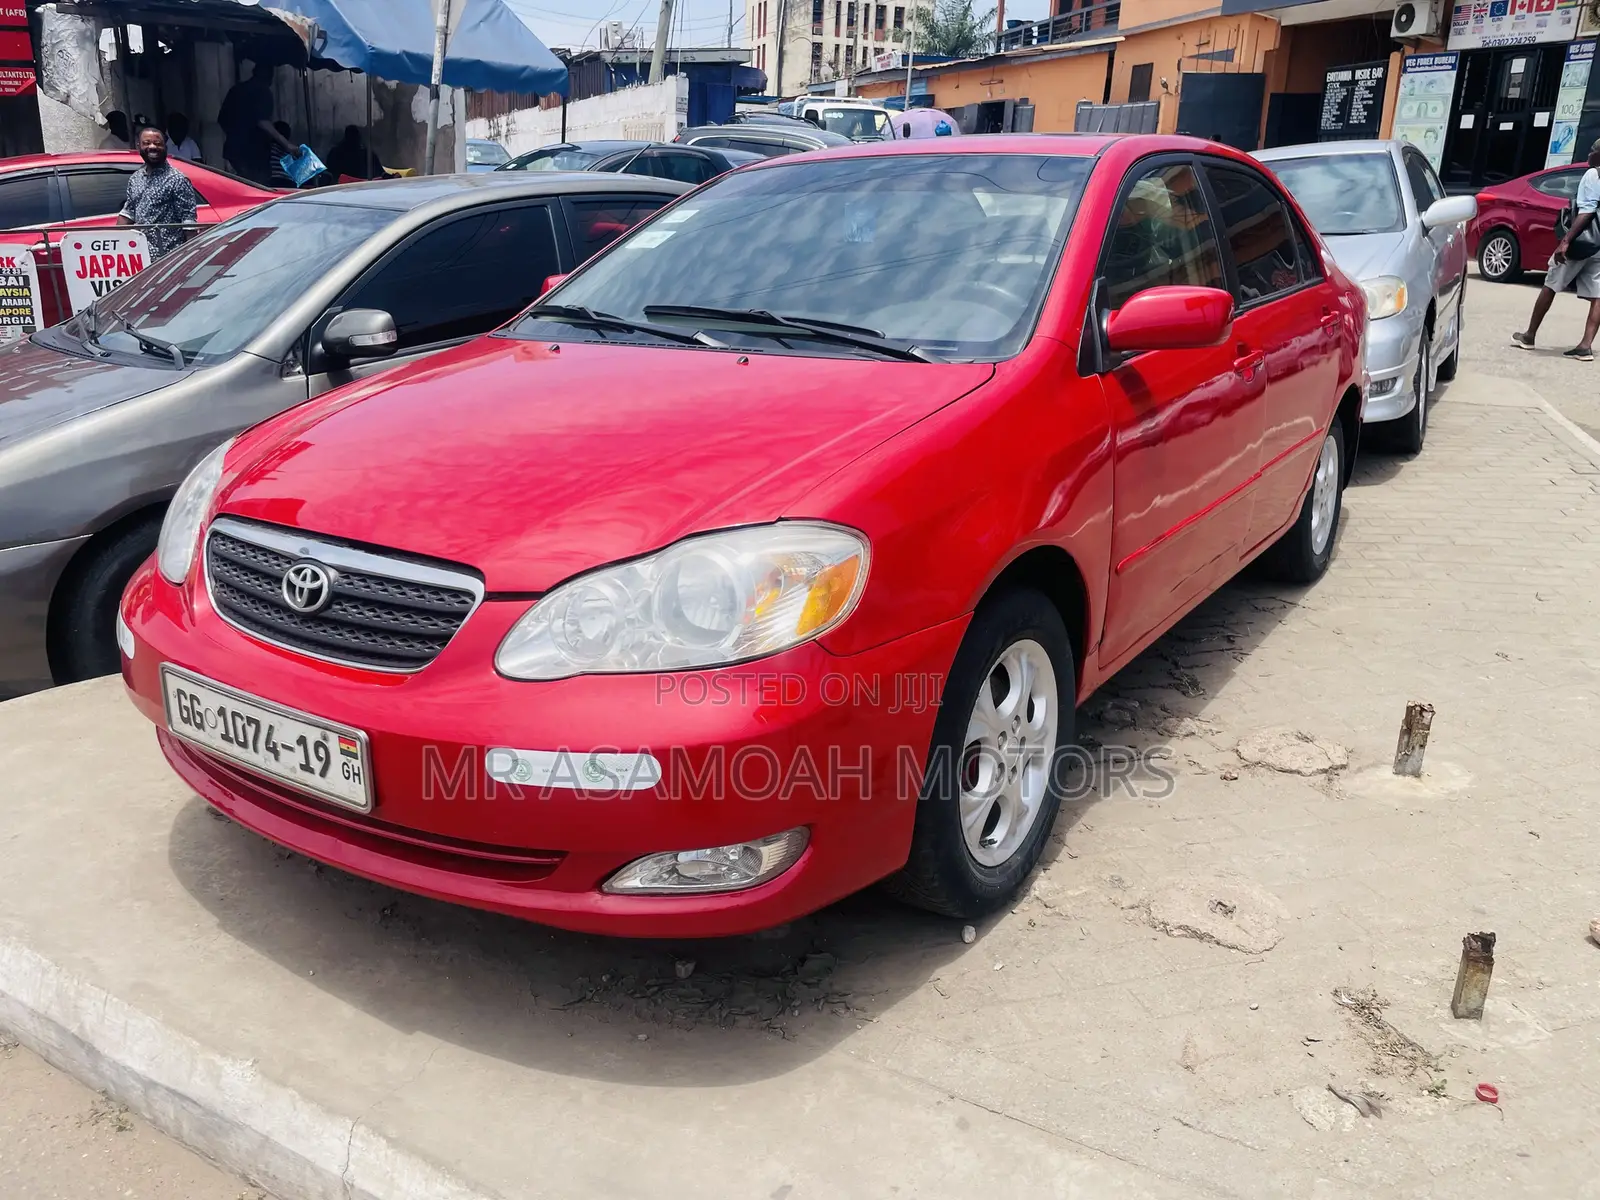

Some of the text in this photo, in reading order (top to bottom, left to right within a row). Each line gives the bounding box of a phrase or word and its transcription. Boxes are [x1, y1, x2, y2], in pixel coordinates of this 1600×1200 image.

[6, 8, 27, 18] (AFD)
[1372, 67, 1384, 79] BAR
[91, 240, 119, 251] GET
[76, 254, 143, 279] JAPAN
[2, 298, 31, 306] ARABIA
[0, 307, 31, 315] APORE
[176, 688, 331, 778] GG 1074-19
[342, 761, 361, 785] GH
